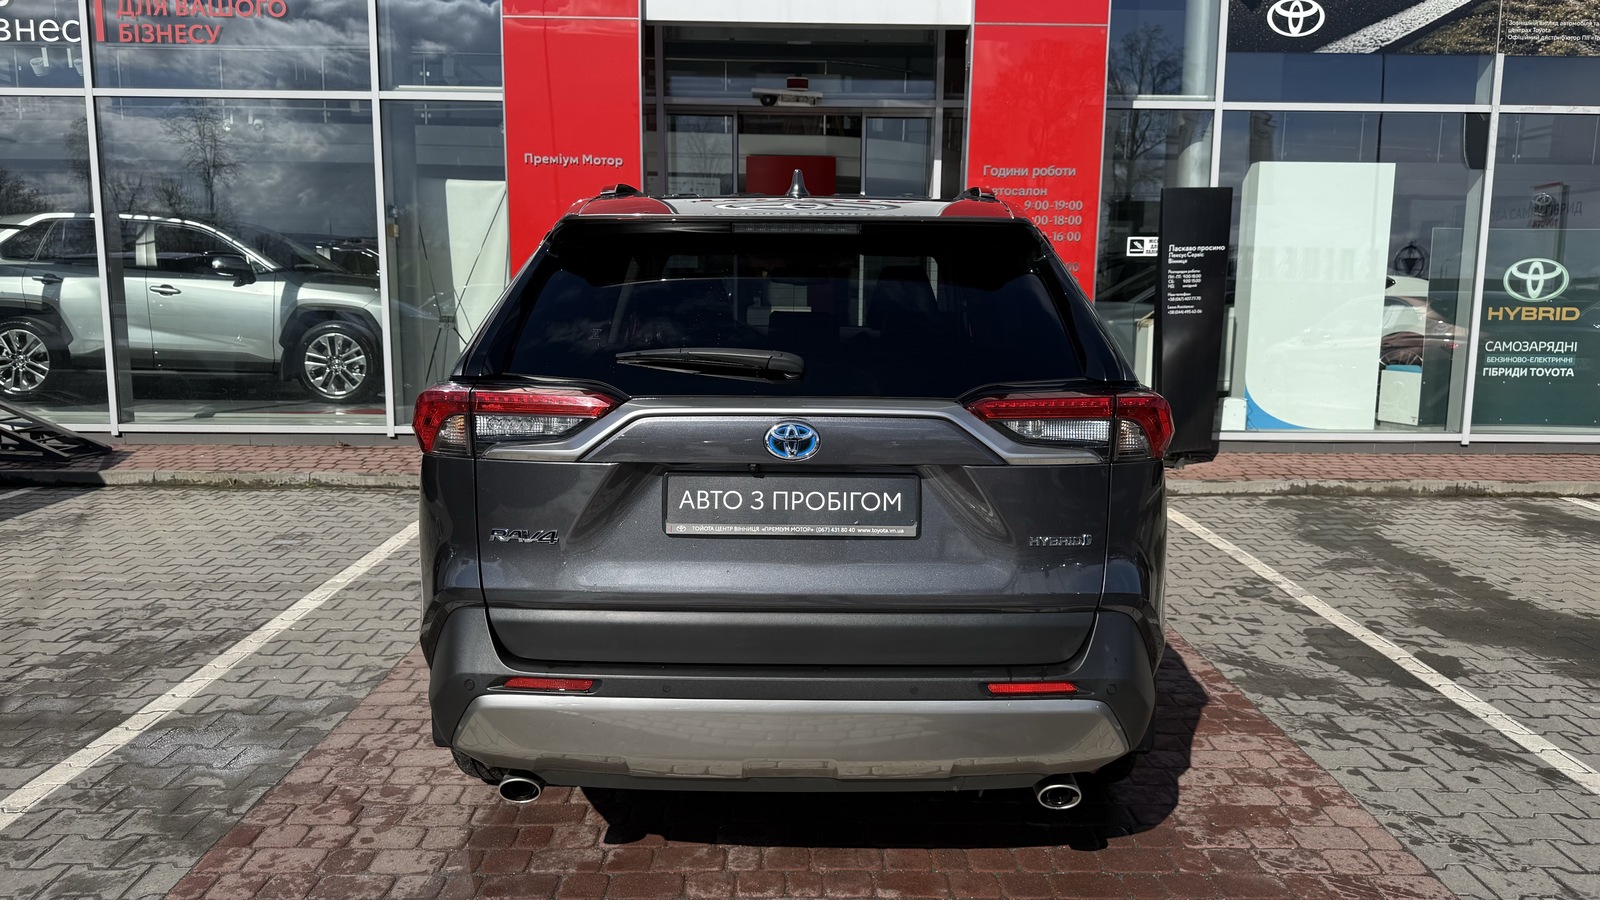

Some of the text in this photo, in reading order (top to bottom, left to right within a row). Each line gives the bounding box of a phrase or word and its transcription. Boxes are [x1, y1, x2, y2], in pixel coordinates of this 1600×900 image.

[116, 0, 287, 19] ДЛЯ ВАШОГО
[119, 24, 221, 44] БІЗНЕСУ
[524, 153, 624, 168] Преміум Мотор
[983, 165, 1077, 179] Години роботи
[986, 186, 1048, 196] втосалон
[1487, 306, 1581, 321] HYBRID
[1484, 340, 1578, 354] САМОЗАРЯДНІ
[1482, 368, 1574, 378] ГІБРИДИ TOYOTA
[679, 490, 902, 512] АВТО З ПРОБІГОМ
[489, 528, 559, 544] RAV4
[1030, 536, 1082, 547] HYBRID
